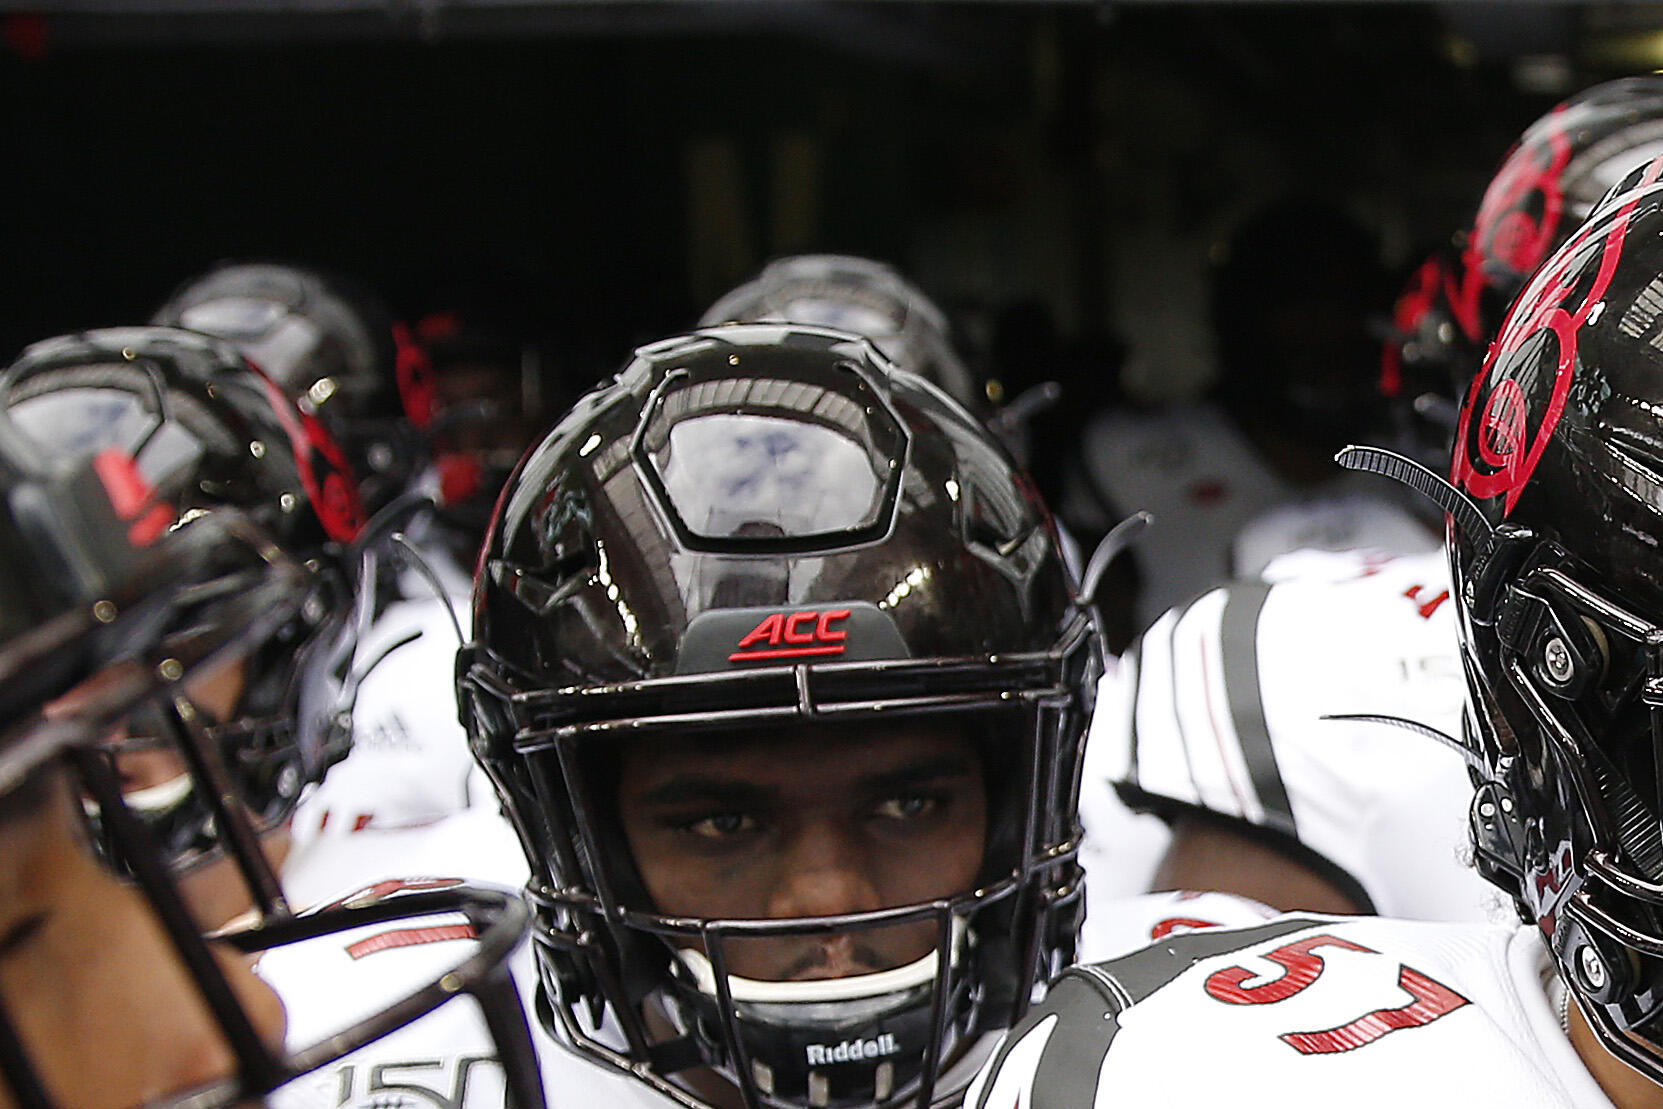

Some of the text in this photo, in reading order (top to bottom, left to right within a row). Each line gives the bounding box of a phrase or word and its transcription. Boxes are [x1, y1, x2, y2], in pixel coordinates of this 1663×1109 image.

[738, 609, 852, 647] ACC
[1203, 933, 1474, 1056] 57
[806, 1034, 893, 1065] Riddell
